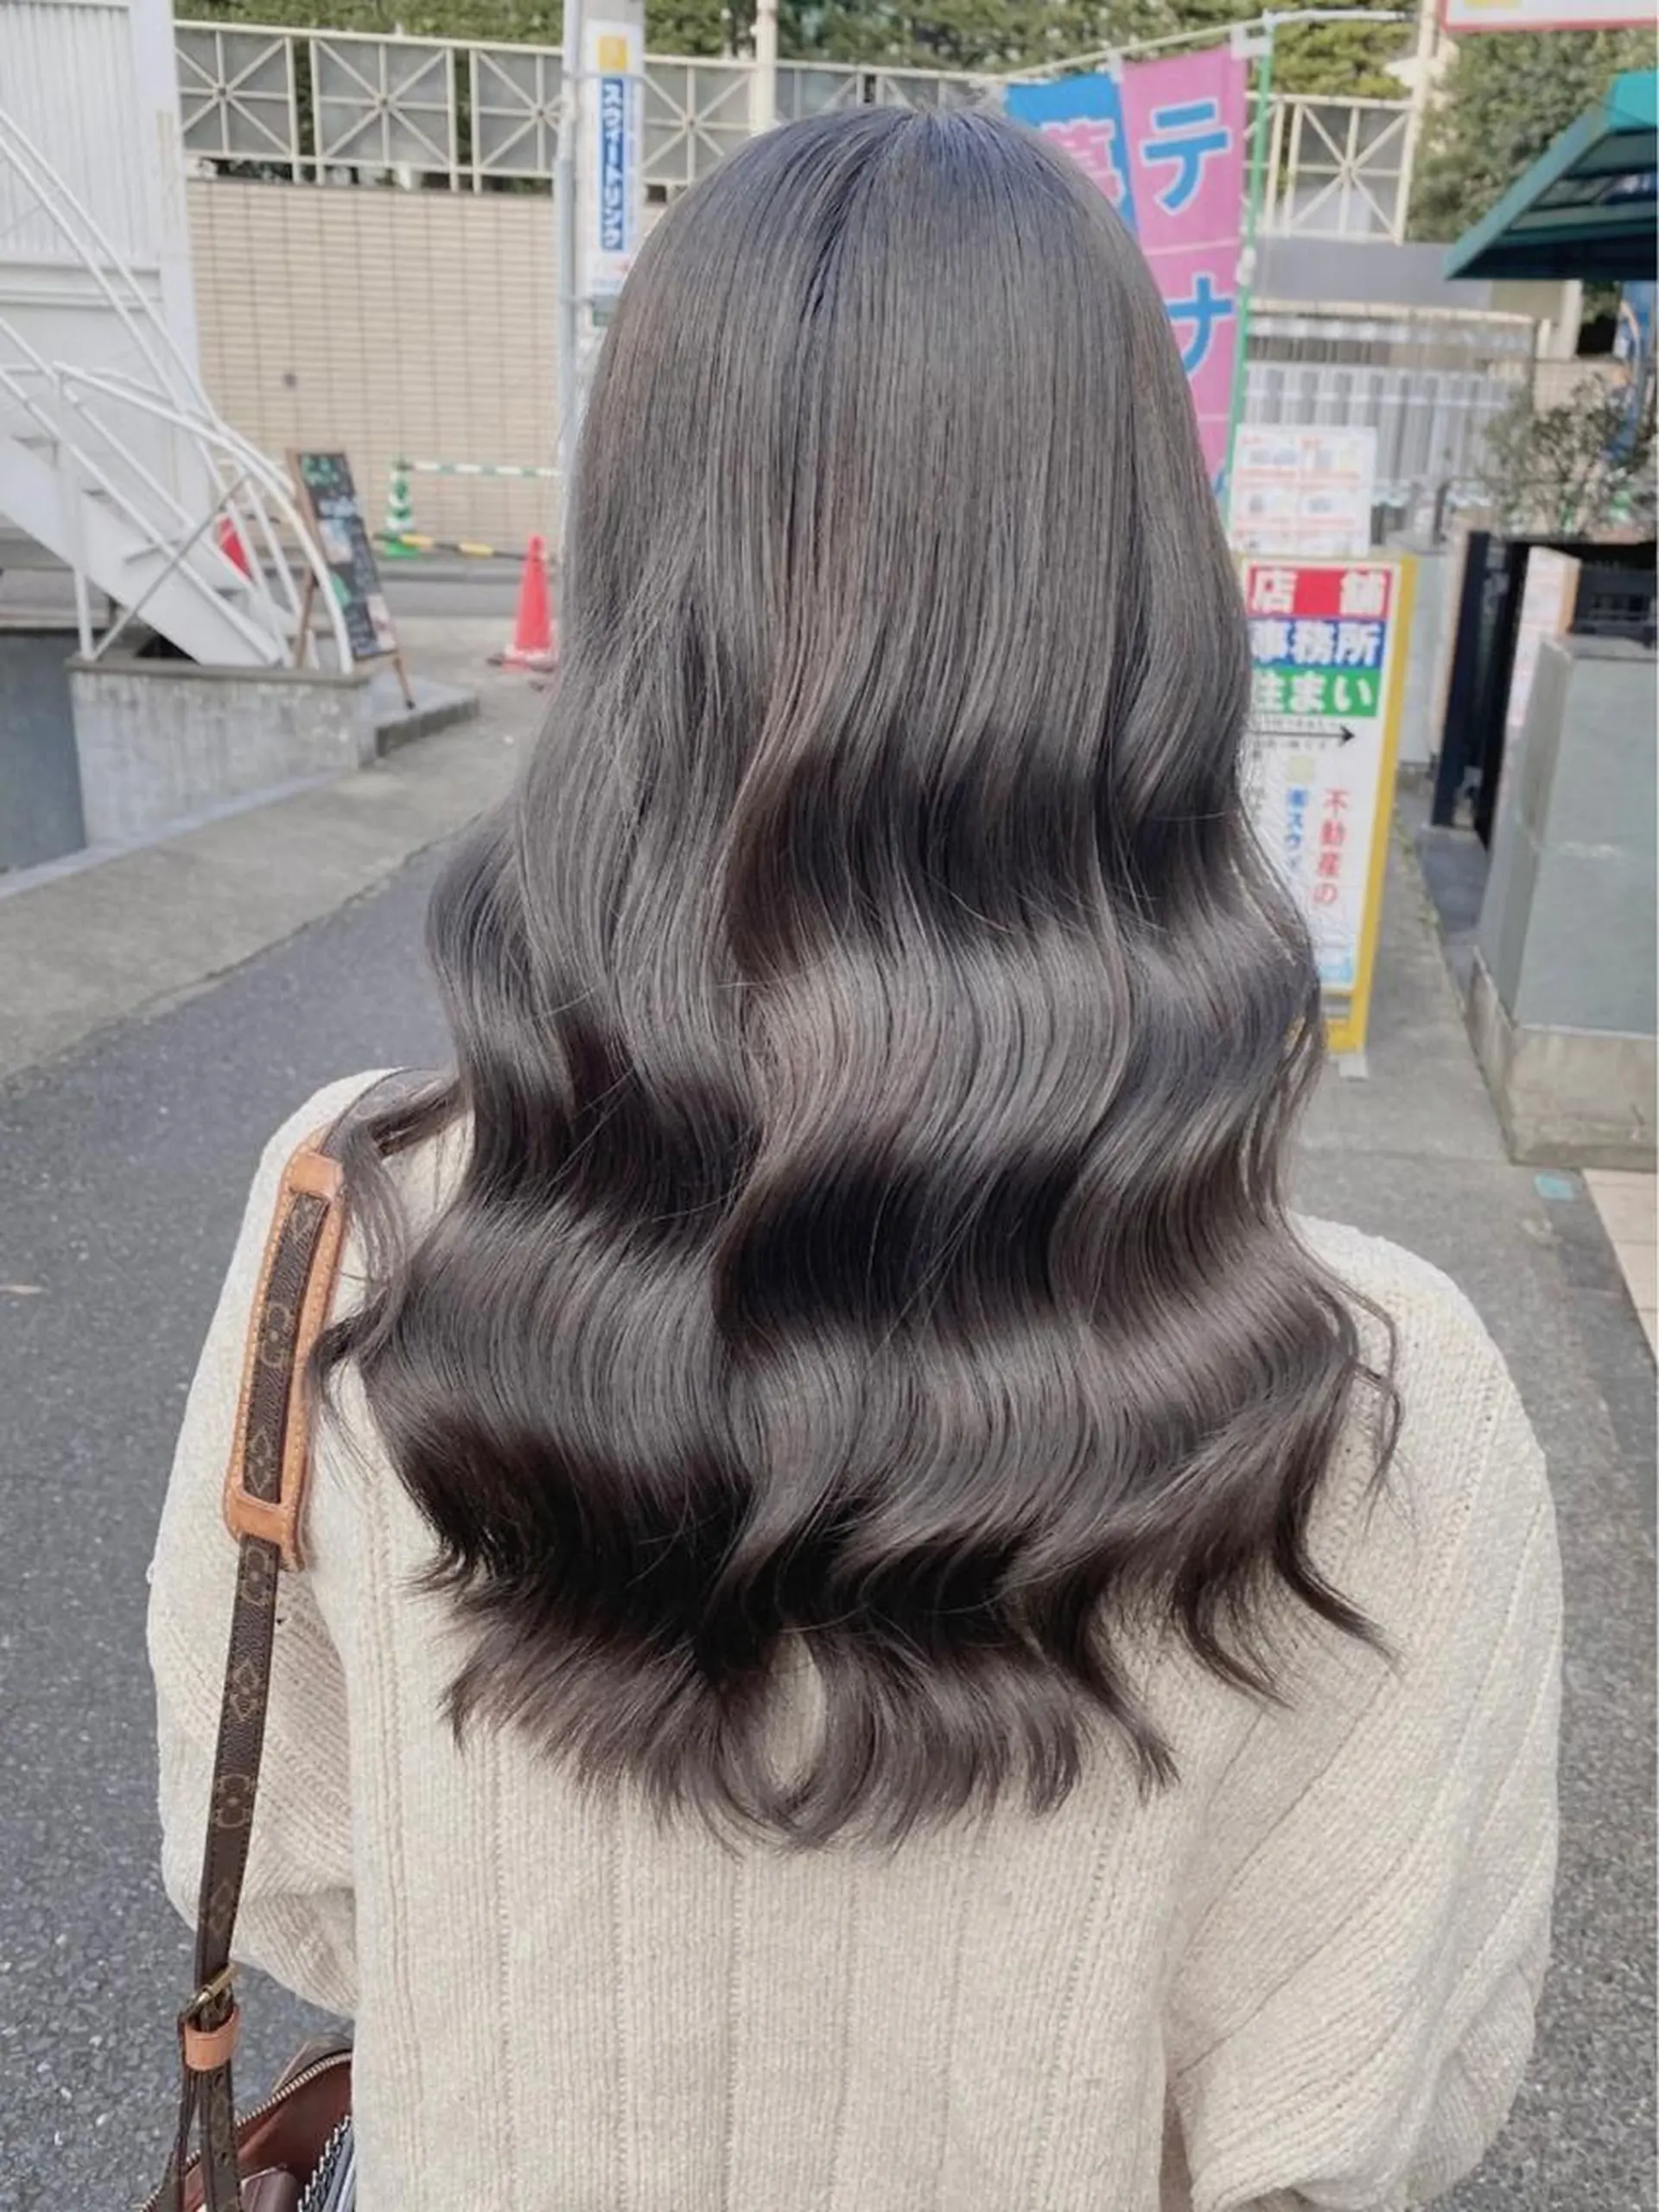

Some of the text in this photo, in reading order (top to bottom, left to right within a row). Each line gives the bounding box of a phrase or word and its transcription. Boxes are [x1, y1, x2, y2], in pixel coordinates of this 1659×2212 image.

[1253, 570, 1386, 616] 店舗
[1250, 620, 1382, 666] 事務所
[1250, 669, 1372, 711] 住まい
[1313, 788, 1349, 905] 不動産の
